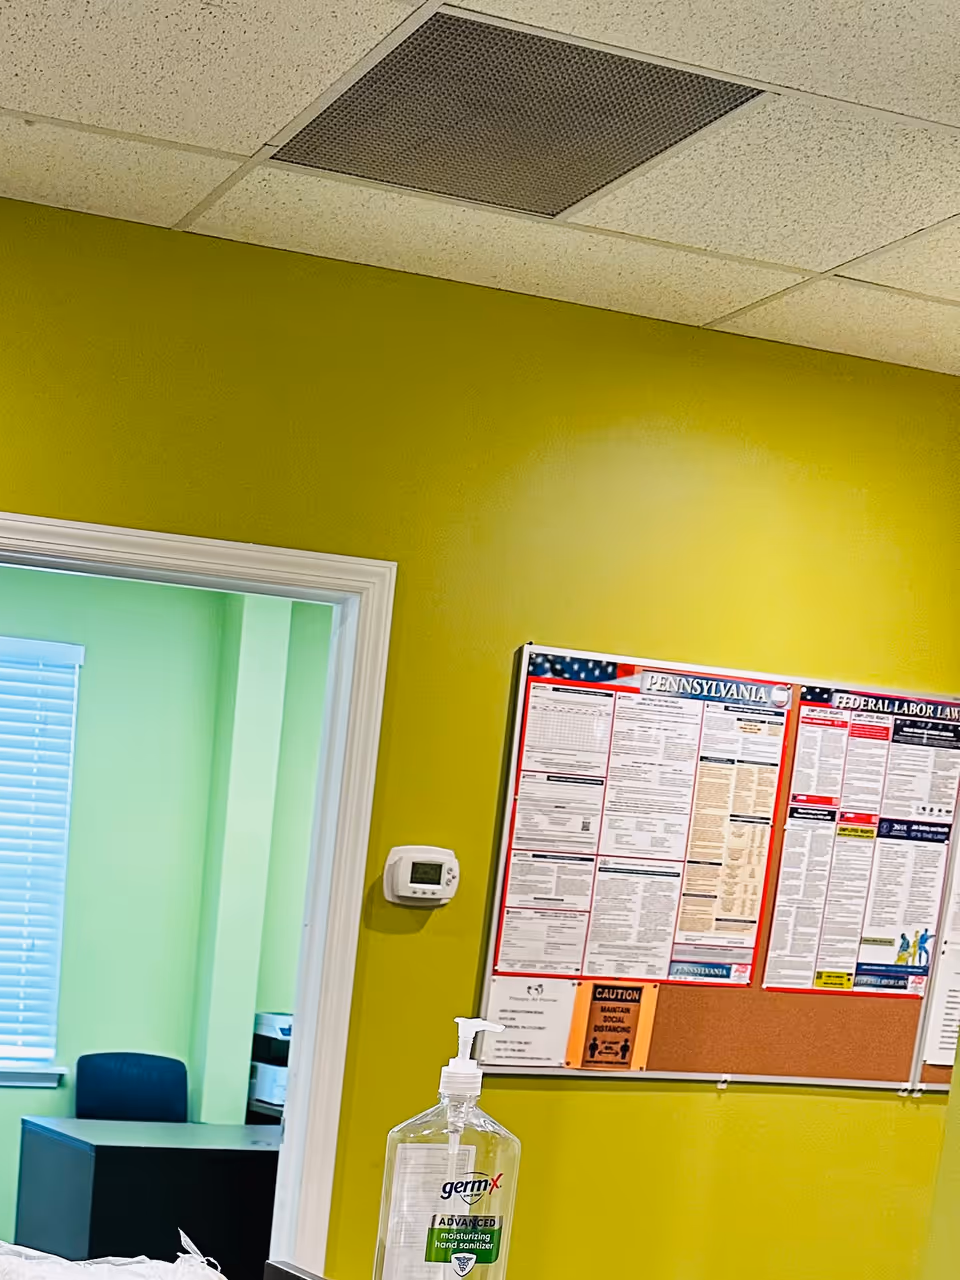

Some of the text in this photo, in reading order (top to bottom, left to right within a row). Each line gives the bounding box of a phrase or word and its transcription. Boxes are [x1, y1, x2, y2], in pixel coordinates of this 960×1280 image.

[646, 675, 768, 702] PENNSYLVANIA
[835, 694, 891, 713] FEDERAL
[893, 700, 934, 717] LABOR
[595, 988, 640, 1000] CAUTION
[600, 1005, 631, 1014] MAINTAIN
[603, 1015, 625, 1023] SOCIAL
[594, 1025, 631, 1034] DISTANCING
[438, 1217, 496, 1228] ADVANCED
[440, 1231, 491, 1243] moisturizing
[434, 1241, 494, 1250] hand sanitizer
